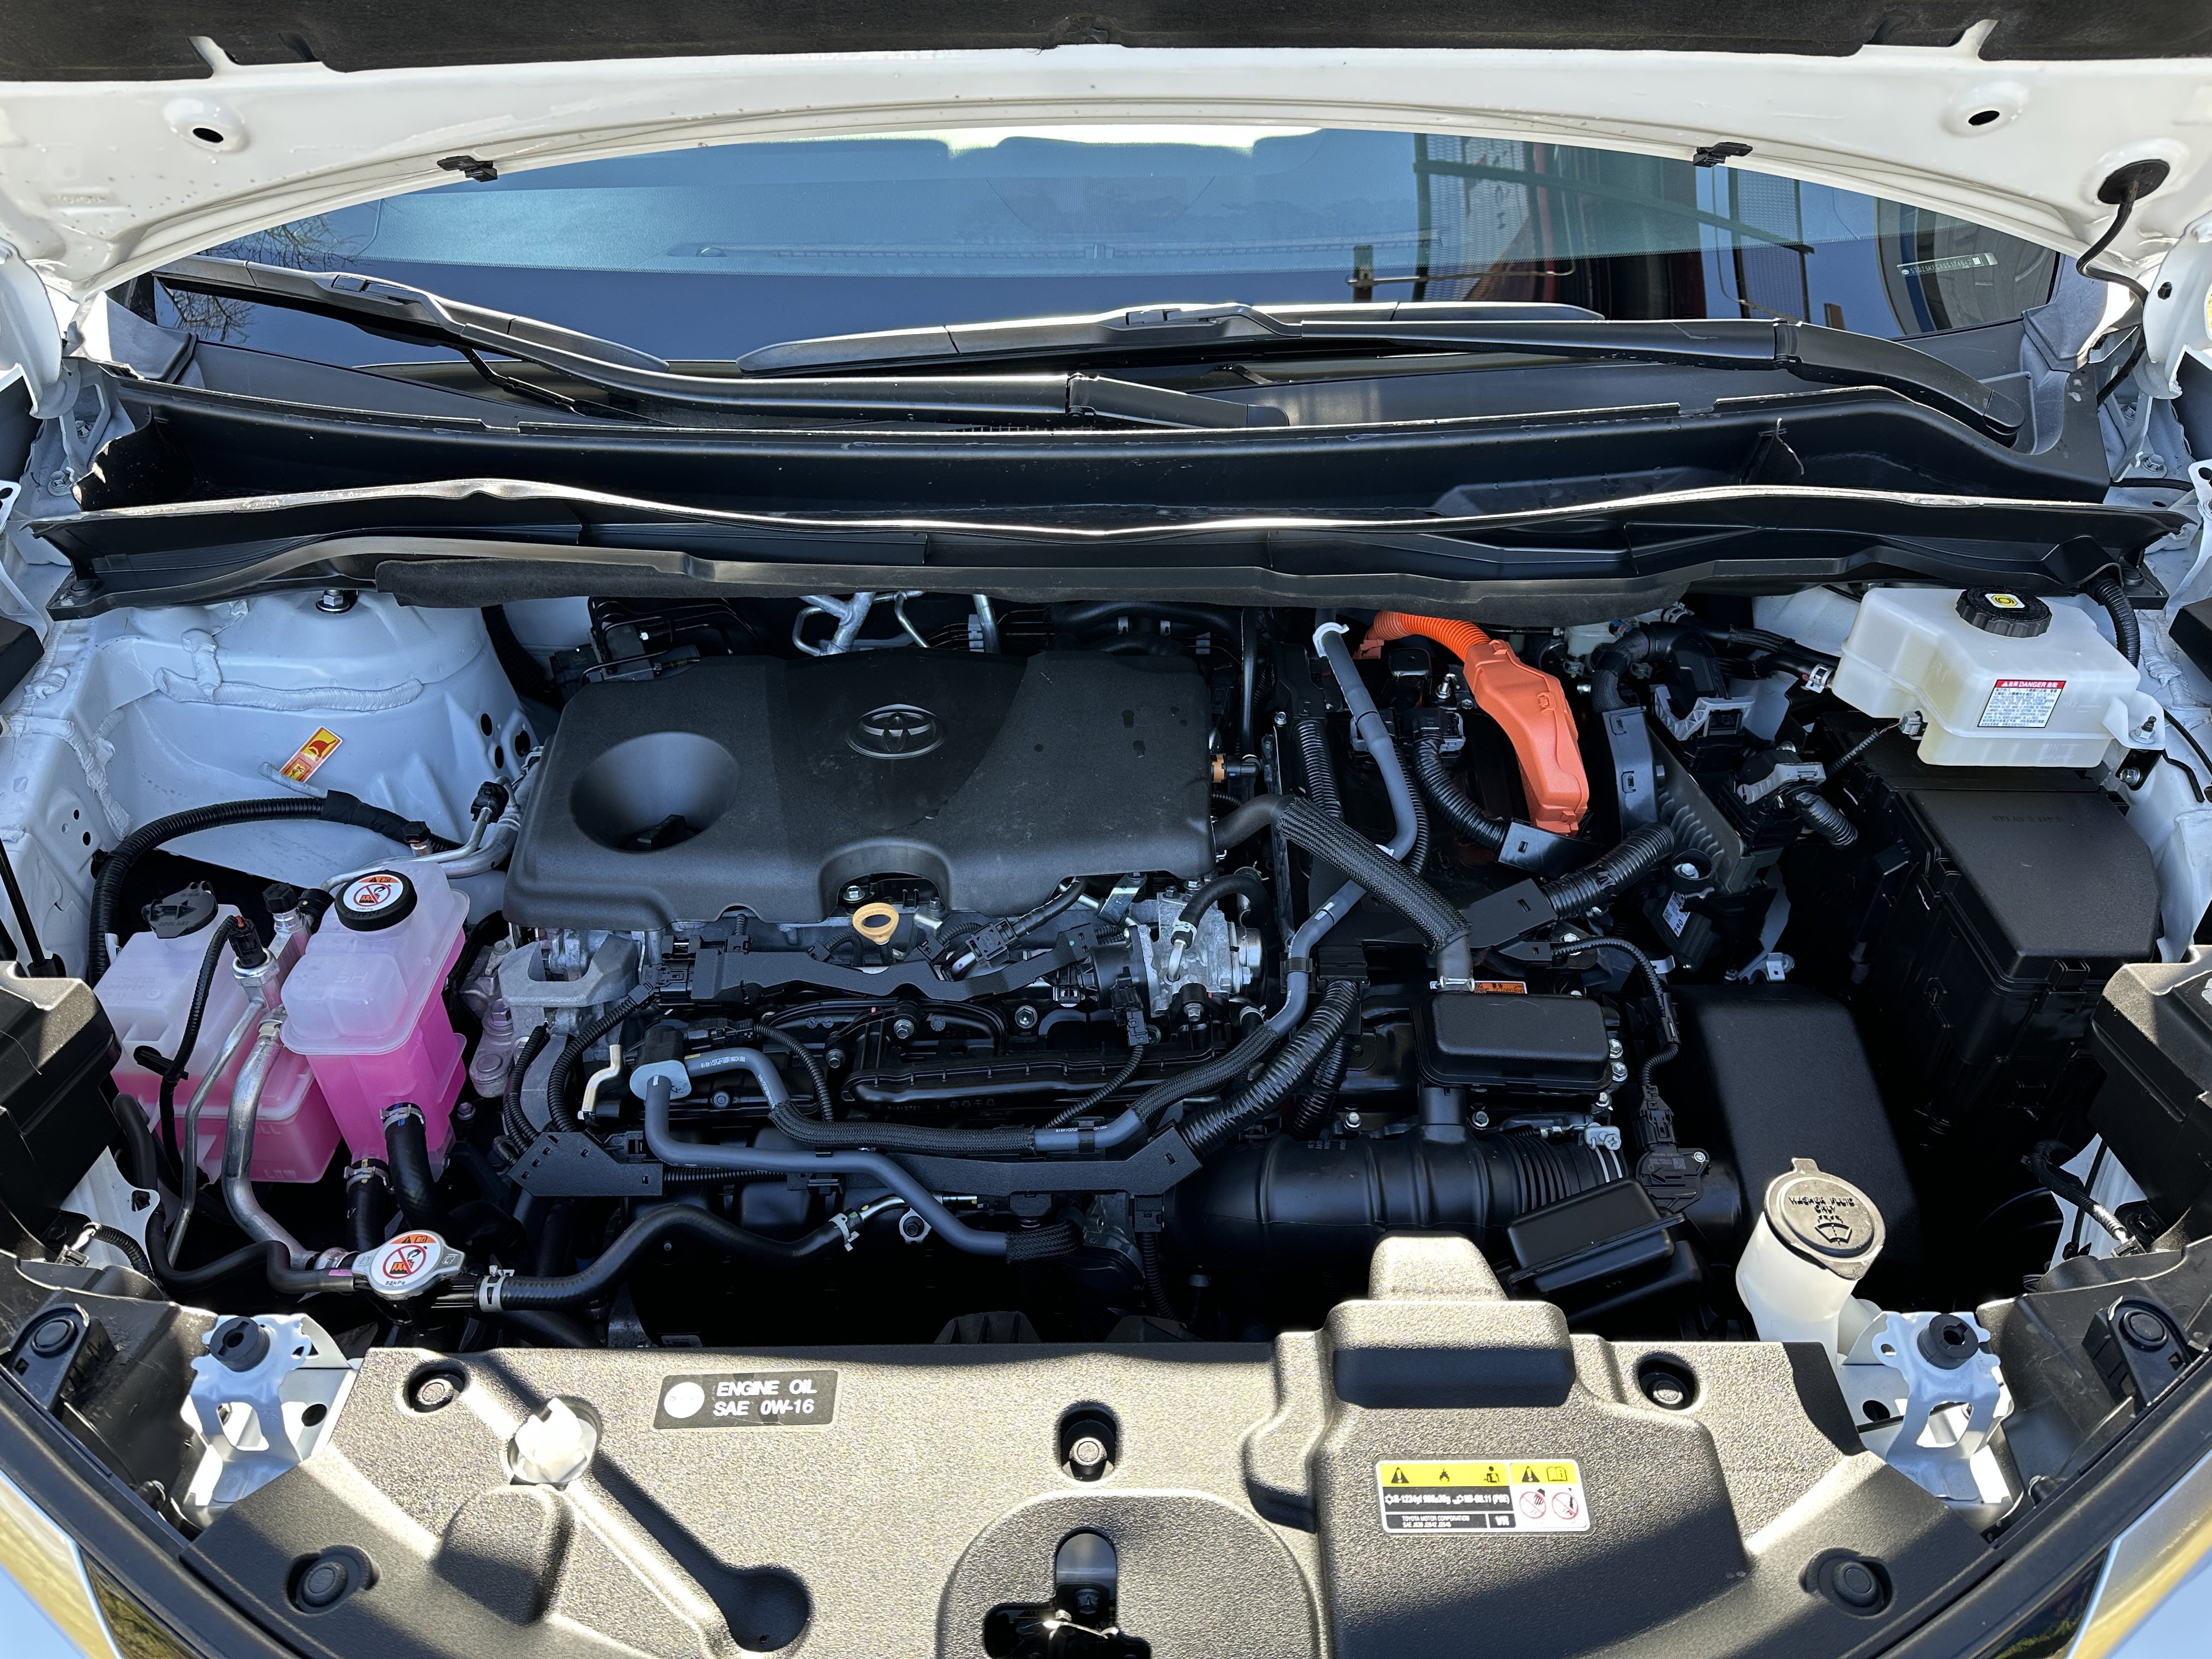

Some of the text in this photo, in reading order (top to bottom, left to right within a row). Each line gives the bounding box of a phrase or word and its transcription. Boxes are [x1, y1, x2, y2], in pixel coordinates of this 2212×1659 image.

[1910, 258, 1972, 274] 5TDZSKFCXSS174642
[1788, 1196, 1855, 1206] WASHER FLUID
[1814, 1204, 1836, 1214] ONLY
[716, 1379, 817, 1397] ENGINE OIL
[713, 1399, 815, 1417] SAE 0W-16
[1495, 1516, 1510, 1526] VR
